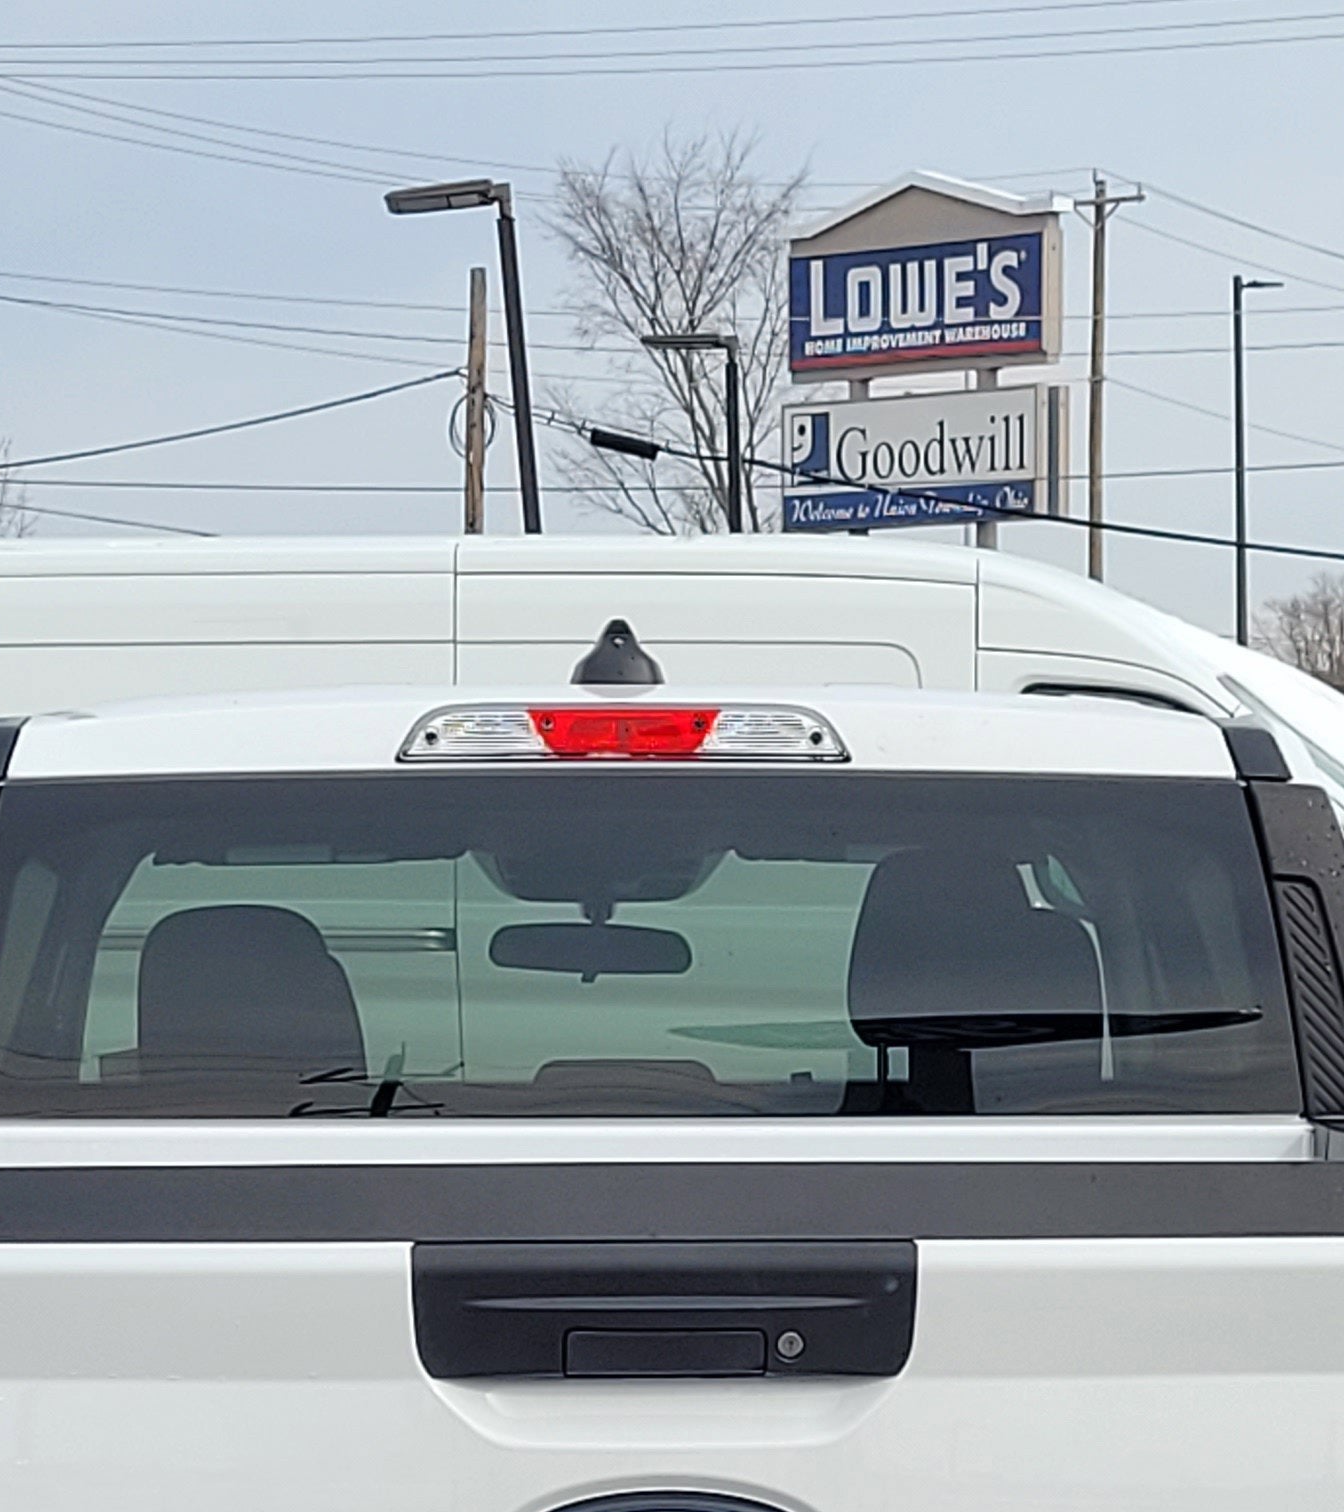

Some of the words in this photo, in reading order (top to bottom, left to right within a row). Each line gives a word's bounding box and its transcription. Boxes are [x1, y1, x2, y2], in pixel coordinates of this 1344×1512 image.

[809, 243, 1021, 336] LOWE'S
[805, 338, 842, 356] HOME
[846, 330, 941, 352] IMPROVEMENT
[944, 322, 1027, 344] WAREHOUSE
[836, 413, 1026, 482] Goodwill
[792, 499, 853, 522] Welcome
[857, 503, 870, 517] to
